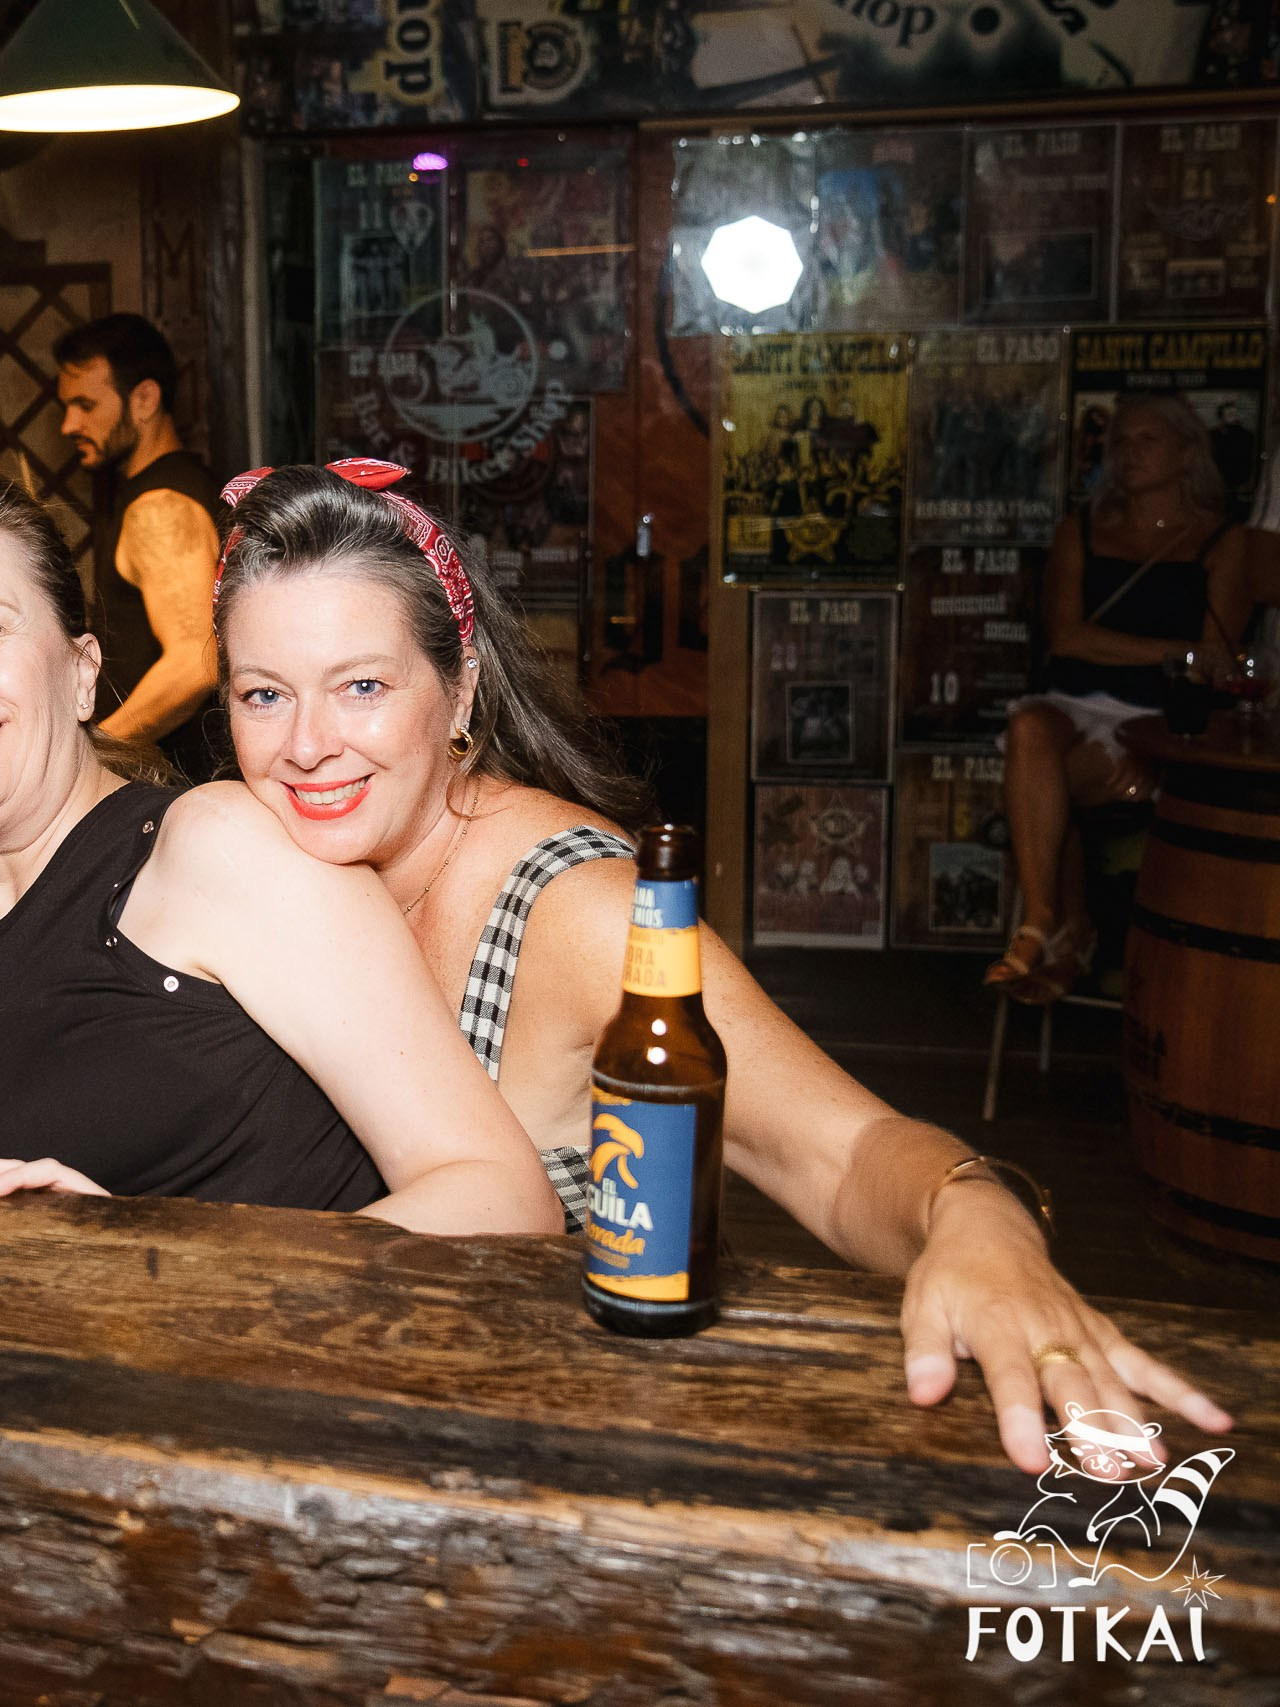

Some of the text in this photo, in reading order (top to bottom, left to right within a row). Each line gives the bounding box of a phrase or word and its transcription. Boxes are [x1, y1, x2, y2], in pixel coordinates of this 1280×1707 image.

[1005, 334, 1059, 362] PASO
[1075, 330, 1265, 372] SANTI CAMPILLO
[941, 547, 1018, 575] EL PASO
[789, 600, 862, 625] EL PASO
[931, 671, 960, 704] 10
[932, 756, 956, 781] EL
